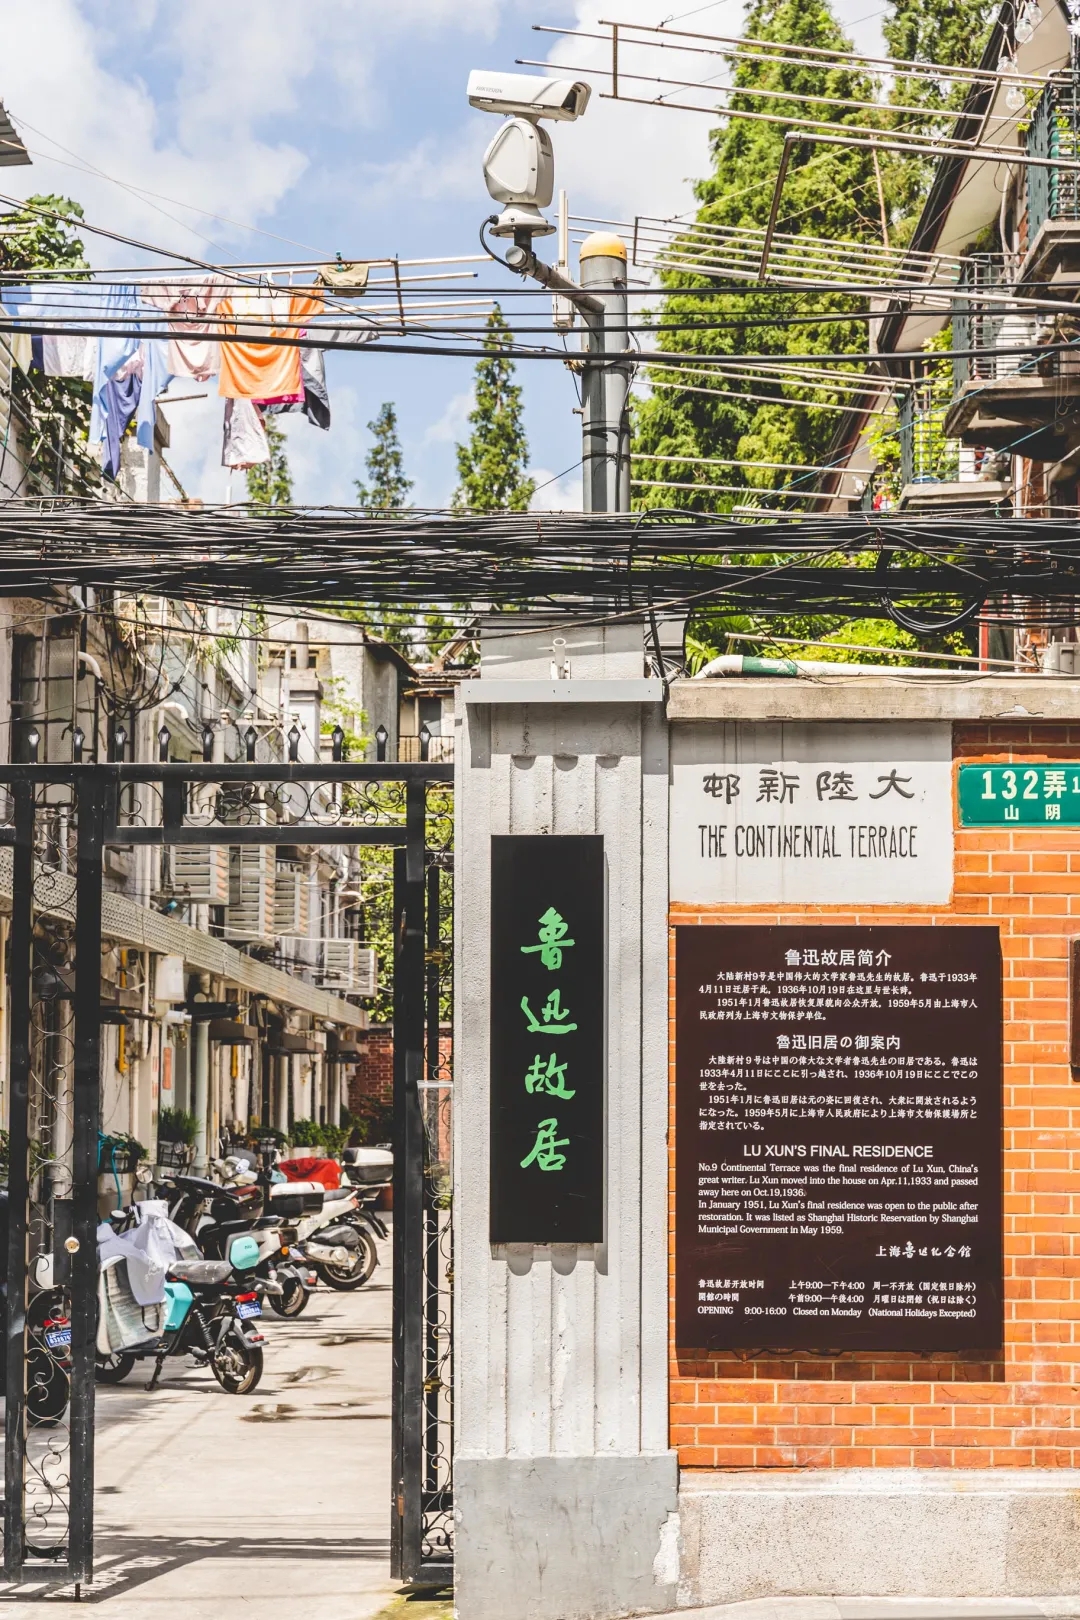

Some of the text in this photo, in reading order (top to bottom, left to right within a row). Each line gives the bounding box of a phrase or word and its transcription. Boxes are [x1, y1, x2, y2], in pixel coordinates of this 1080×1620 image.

[698, 825, 918, 858] THE CONTINENTAL TERRACE
[784, 948, 892, 967] 鲁迅故居简介
[699, 1010, 827, 1021] 民政府列为上海市文物保护单位。
[776, 1034, 901, 1051] 魯迅旧居の御案内
[698, 1081, 747, 1092] 世を去った。
[698, 1120, 765, 1131] 指定されている。
[744, 1144, 761, 1157] LU
[810, 1144, 850, 1158] FINAL
[852, 1145, 934, 1158] RESIDENCE
[698, 1162, 718, 1172] No.9
[720, 1162, 767, 1172] Continental
[769, 1163, 801, 1172] Terrace
[803, 1165, 820, 1173] was
[822, 1163, 836, 1173] the
[838, 1163, 857, 1173] final
[859, 1163, 899, 1173] residence
[901, 1163, 910, 1173] of
[913, 1164, 923, 1173] Lu
[926, 1164, 946, 1174] Xun,
[698, 1175, 979, 1188] great writer. Lu Xun moved into the house on Apr.11,1933 and passed
[698, 1187, 806, 1199] away here on Oct.19,1936.
[699, 1199, 706, 1209] In
[708, 1199, 741, 1211] January
[743, 1200, 767, 1210] 1951,
[769, 1200, 779, 1209] Lu
[806, 1200, 825, 1210] final
[826, 1200, 866, 1210] residence
[866, 1202, 884, 1210] was
[884, 1203, 906, 1212] open
[907, 1202, 915, 1210] to
[917, 1201, 931, 1210] the
[932, 1201, 958, 1213] public
[958, 1201, 979, 1211] after
[698, 1212, 979, 1225] restoration. It was listed as Shanghai Historic Reservation by Shanghai
[698, 1224, 844, 1237] Municipal Government in May 1959.
[697, 1305, 734, 1315] OPENING
[744, 1306, 787, 1316] 9:00-16:00
[792, 1306, 819, 1316] Closed
[830, 1307, 863, 1319] Monday
[867, 1307, 904, 1317] (National
[904, 1308, 938, 1320] Holidays
[938, 1308, 977, 1320] Excepted)
